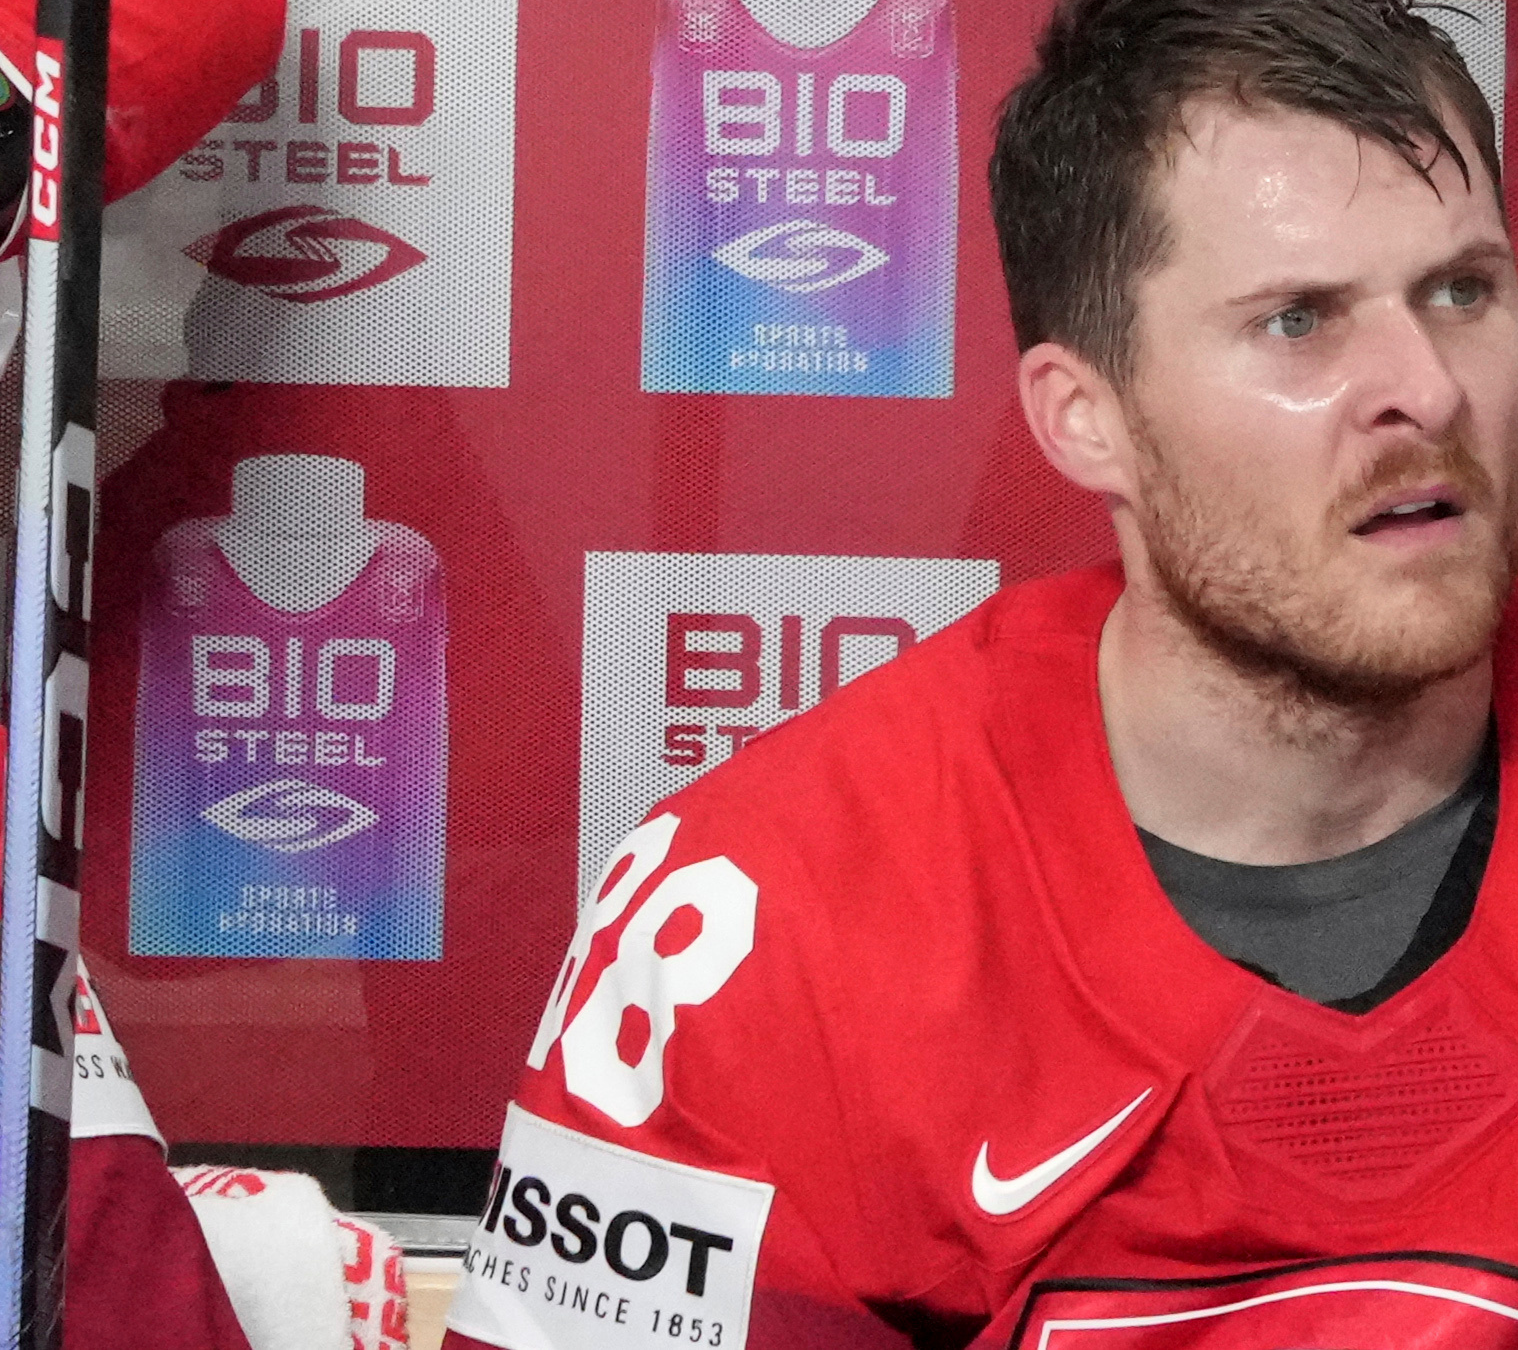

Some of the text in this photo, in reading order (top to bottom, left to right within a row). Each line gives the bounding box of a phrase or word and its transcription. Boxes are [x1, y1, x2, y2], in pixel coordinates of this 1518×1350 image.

[33, 51, 61, 226] CCM
[703, 71, 907, 159] BIO
[706, 168, 896, 206] STEEL
[192, 635, 396, 721] BIO
[193, 728, 386, 767] STEEL
[544, 1276, 630, 1325] SINCE
[652, 1308, 725, 1349] 1853
